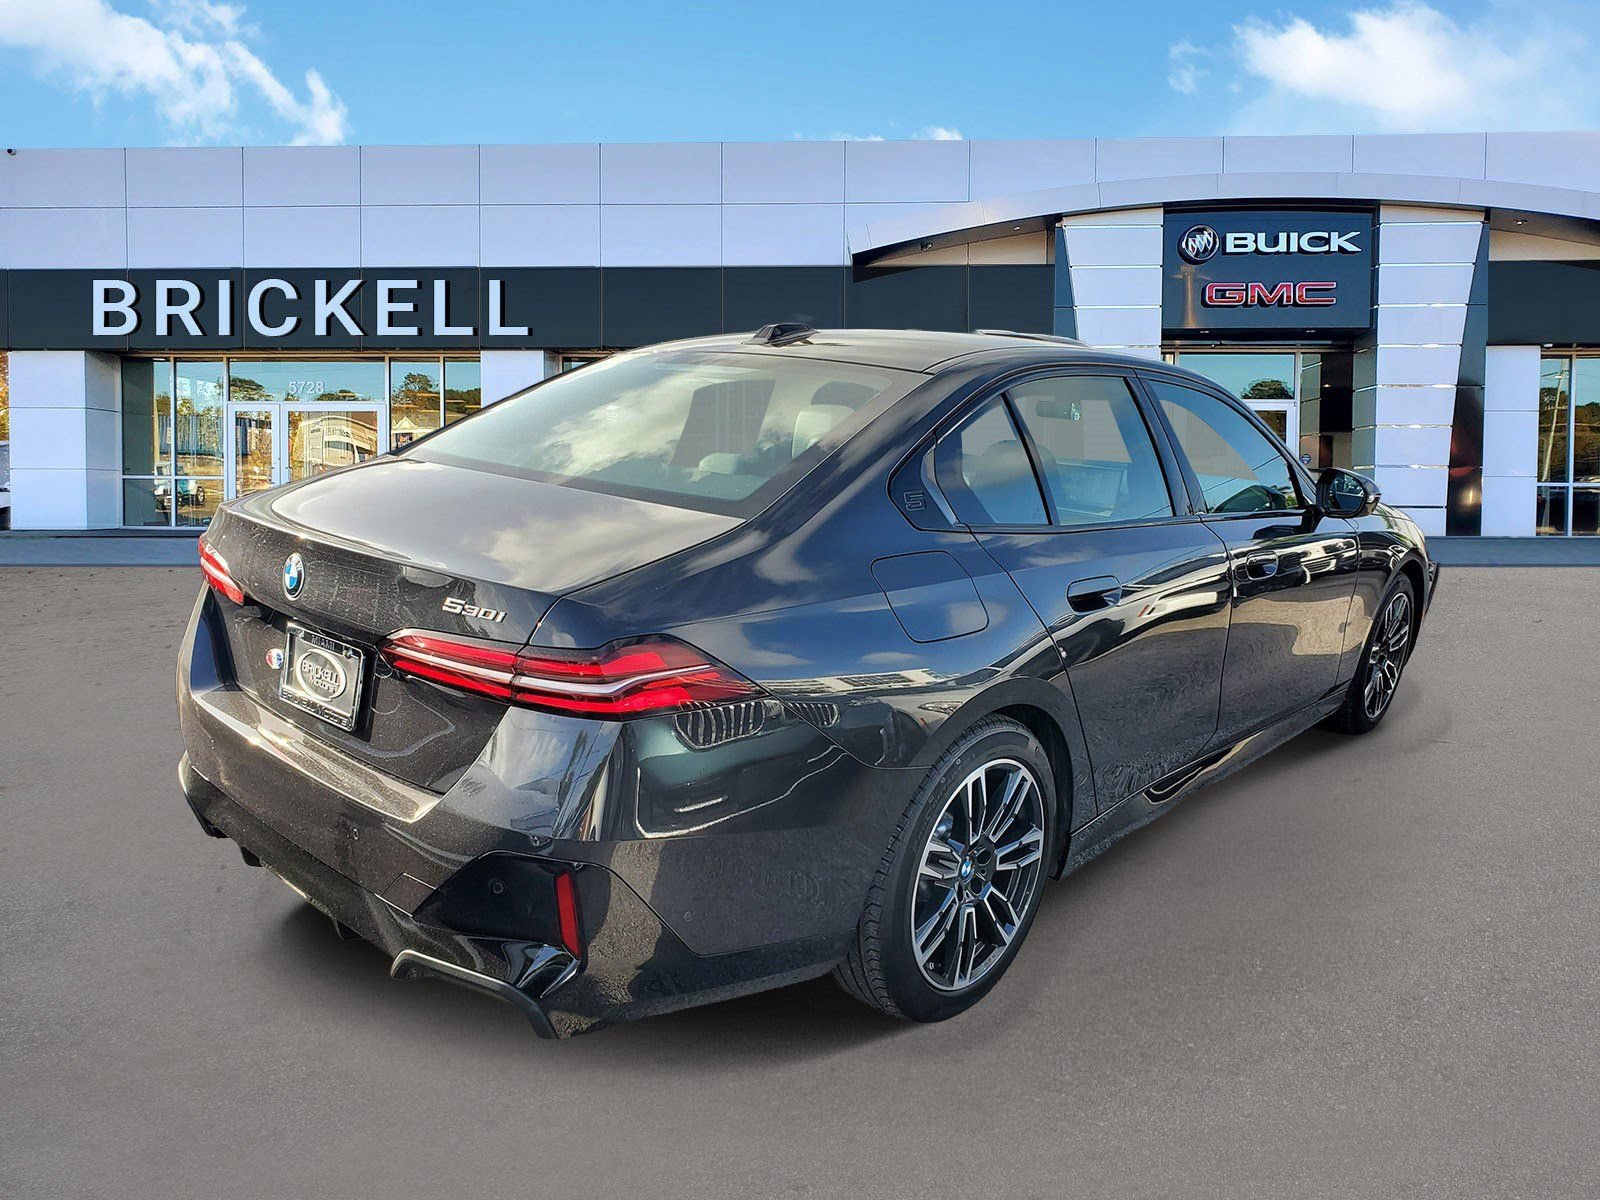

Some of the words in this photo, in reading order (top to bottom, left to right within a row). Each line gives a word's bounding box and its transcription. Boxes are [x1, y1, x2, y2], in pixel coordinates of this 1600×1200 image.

[1226, 231, 1361, 253] BUICK
[1205, 282, 1337, 305] GMC
[92, 278, 530, 337] BRICKELL
[288, 381, 325, 394] 5728
[311, 634, 335, 650] MIAMI
[302, 659, 340, 686] BRICKELL
